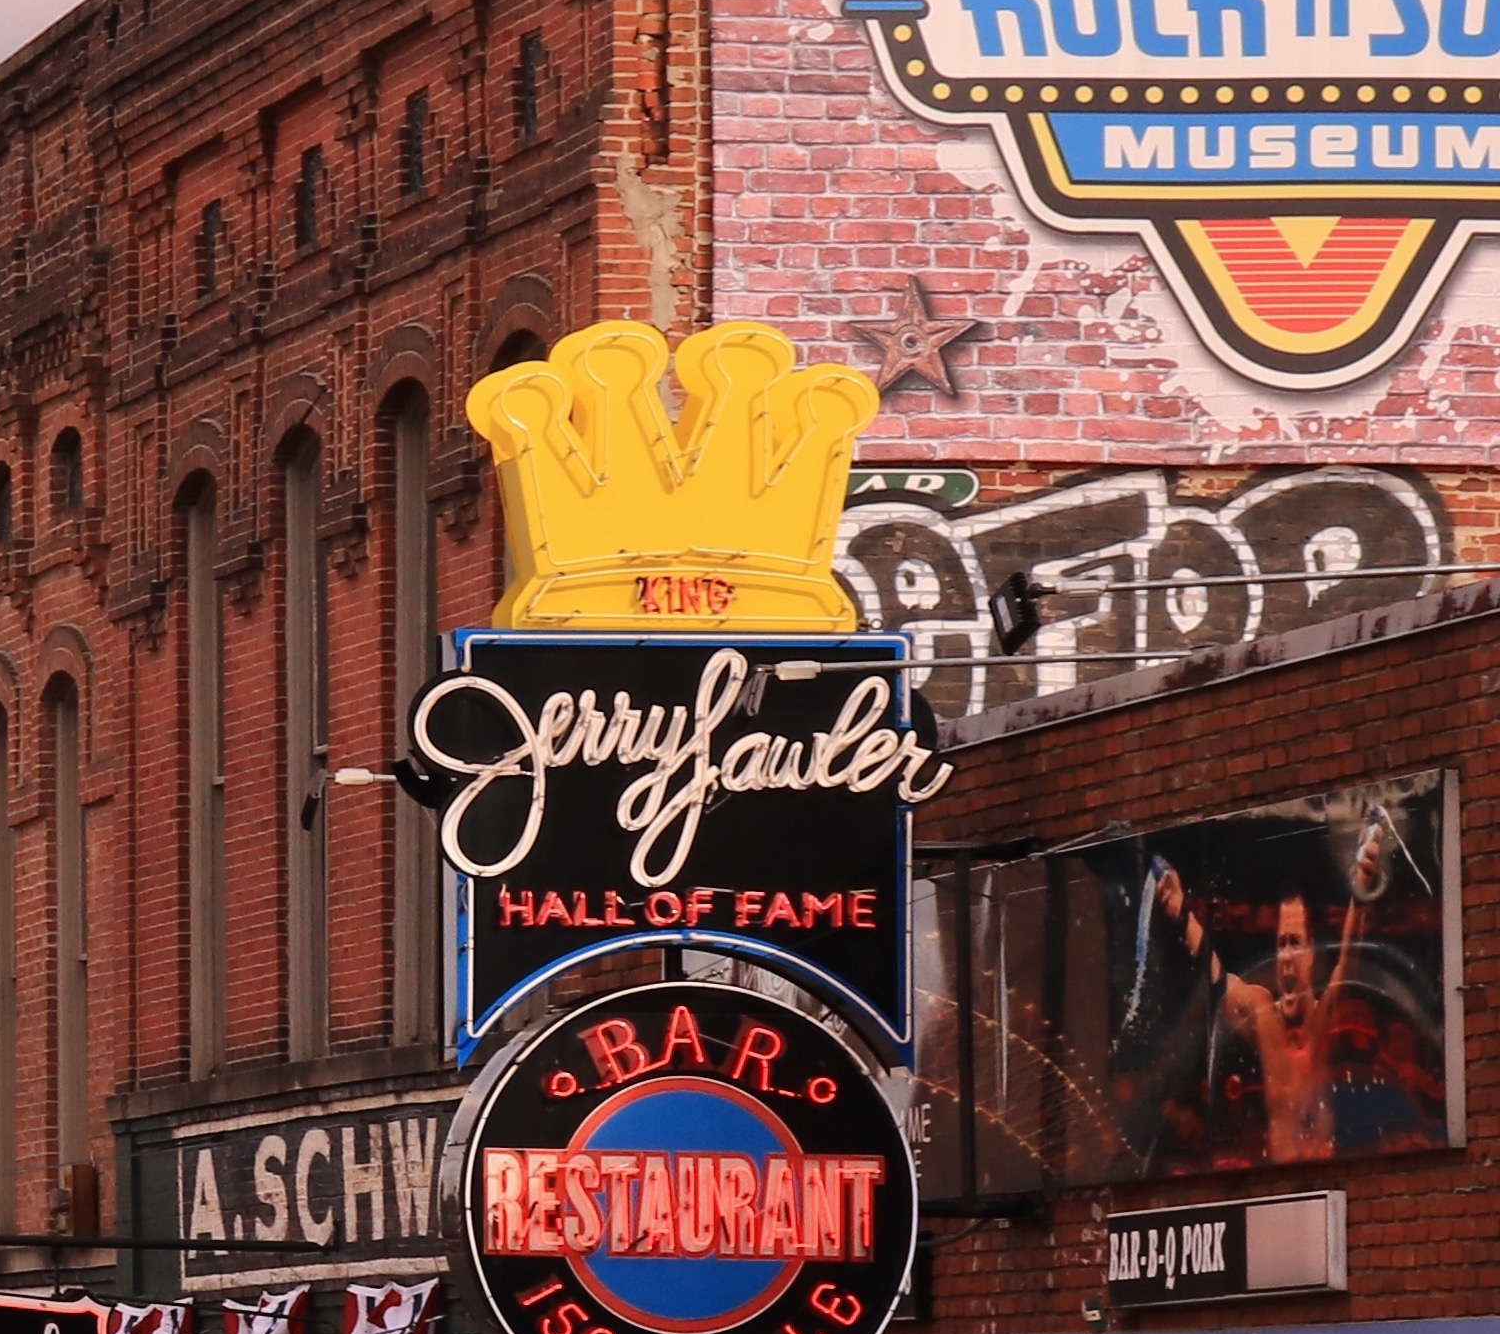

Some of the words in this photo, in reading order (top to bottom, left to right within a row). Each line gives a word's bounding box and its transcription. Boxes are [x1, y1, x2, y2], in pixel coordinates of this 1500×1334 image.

[637, 575, 736, 615] KING
[412, 674, 690, 877] Jerry
[629, 647, 956, 888] Lawler
[499, 890, 636, 927] HALL
[644, 890, 714, 925] OF
[735, 889, 878, 929] FAME
[595, 1005, 783, 1091] BAR
[484, 1148, 884, 1261] RESTAURANT
[1108, 1225, 1177, 1291] BAR-B-Q
[1180, 1220, 1226, 1273] PORK
